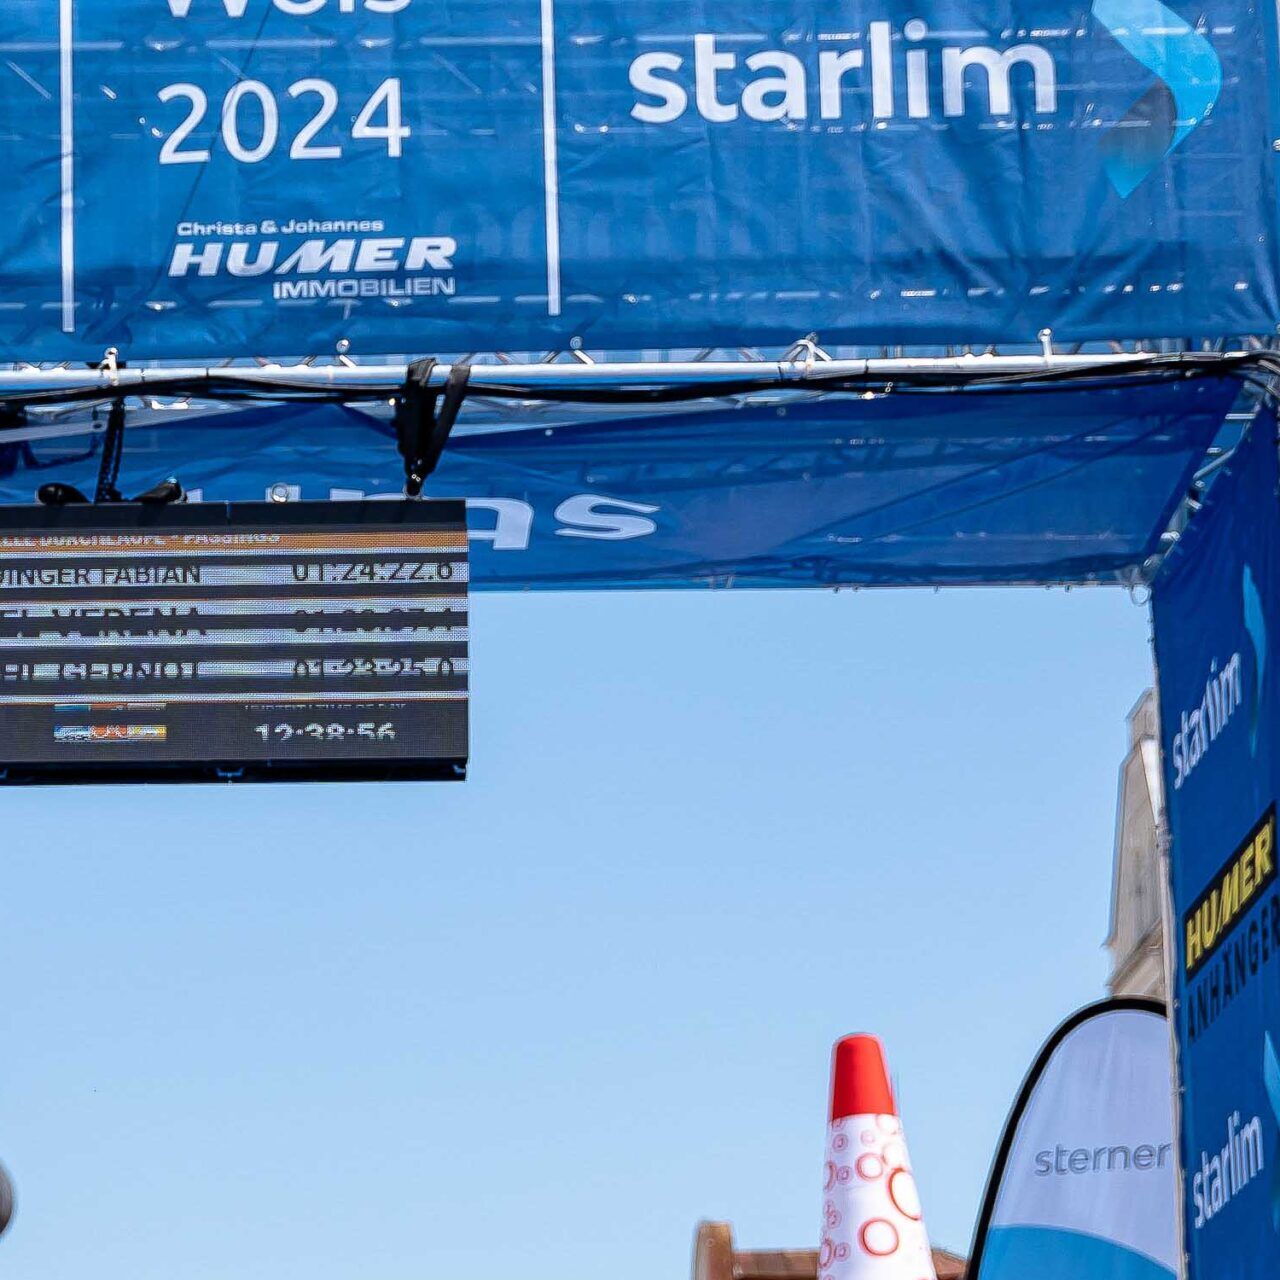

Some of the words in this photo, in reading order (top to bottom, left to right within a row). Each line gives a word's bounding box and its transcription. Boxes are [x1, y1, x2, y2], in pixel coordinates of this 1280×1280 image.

[627, 20, 1058, 124] starlim
[157, 77, 411, 165] 2024
[168, 236, 458, 277] HUMER
[176, 221, 257, 236] Christa
[260, 220, 278, 234] &
[281, 218, 385, 235] Johannes
[103, 562, 201, 584] FABIAN
[1172, 650, 1242, 790] starlim
[1186, 818, 1273, 970] HUMER
[1035, 1140, 1170, 1178] sterner
[1193, 1110, 1265, 1229] starlim
